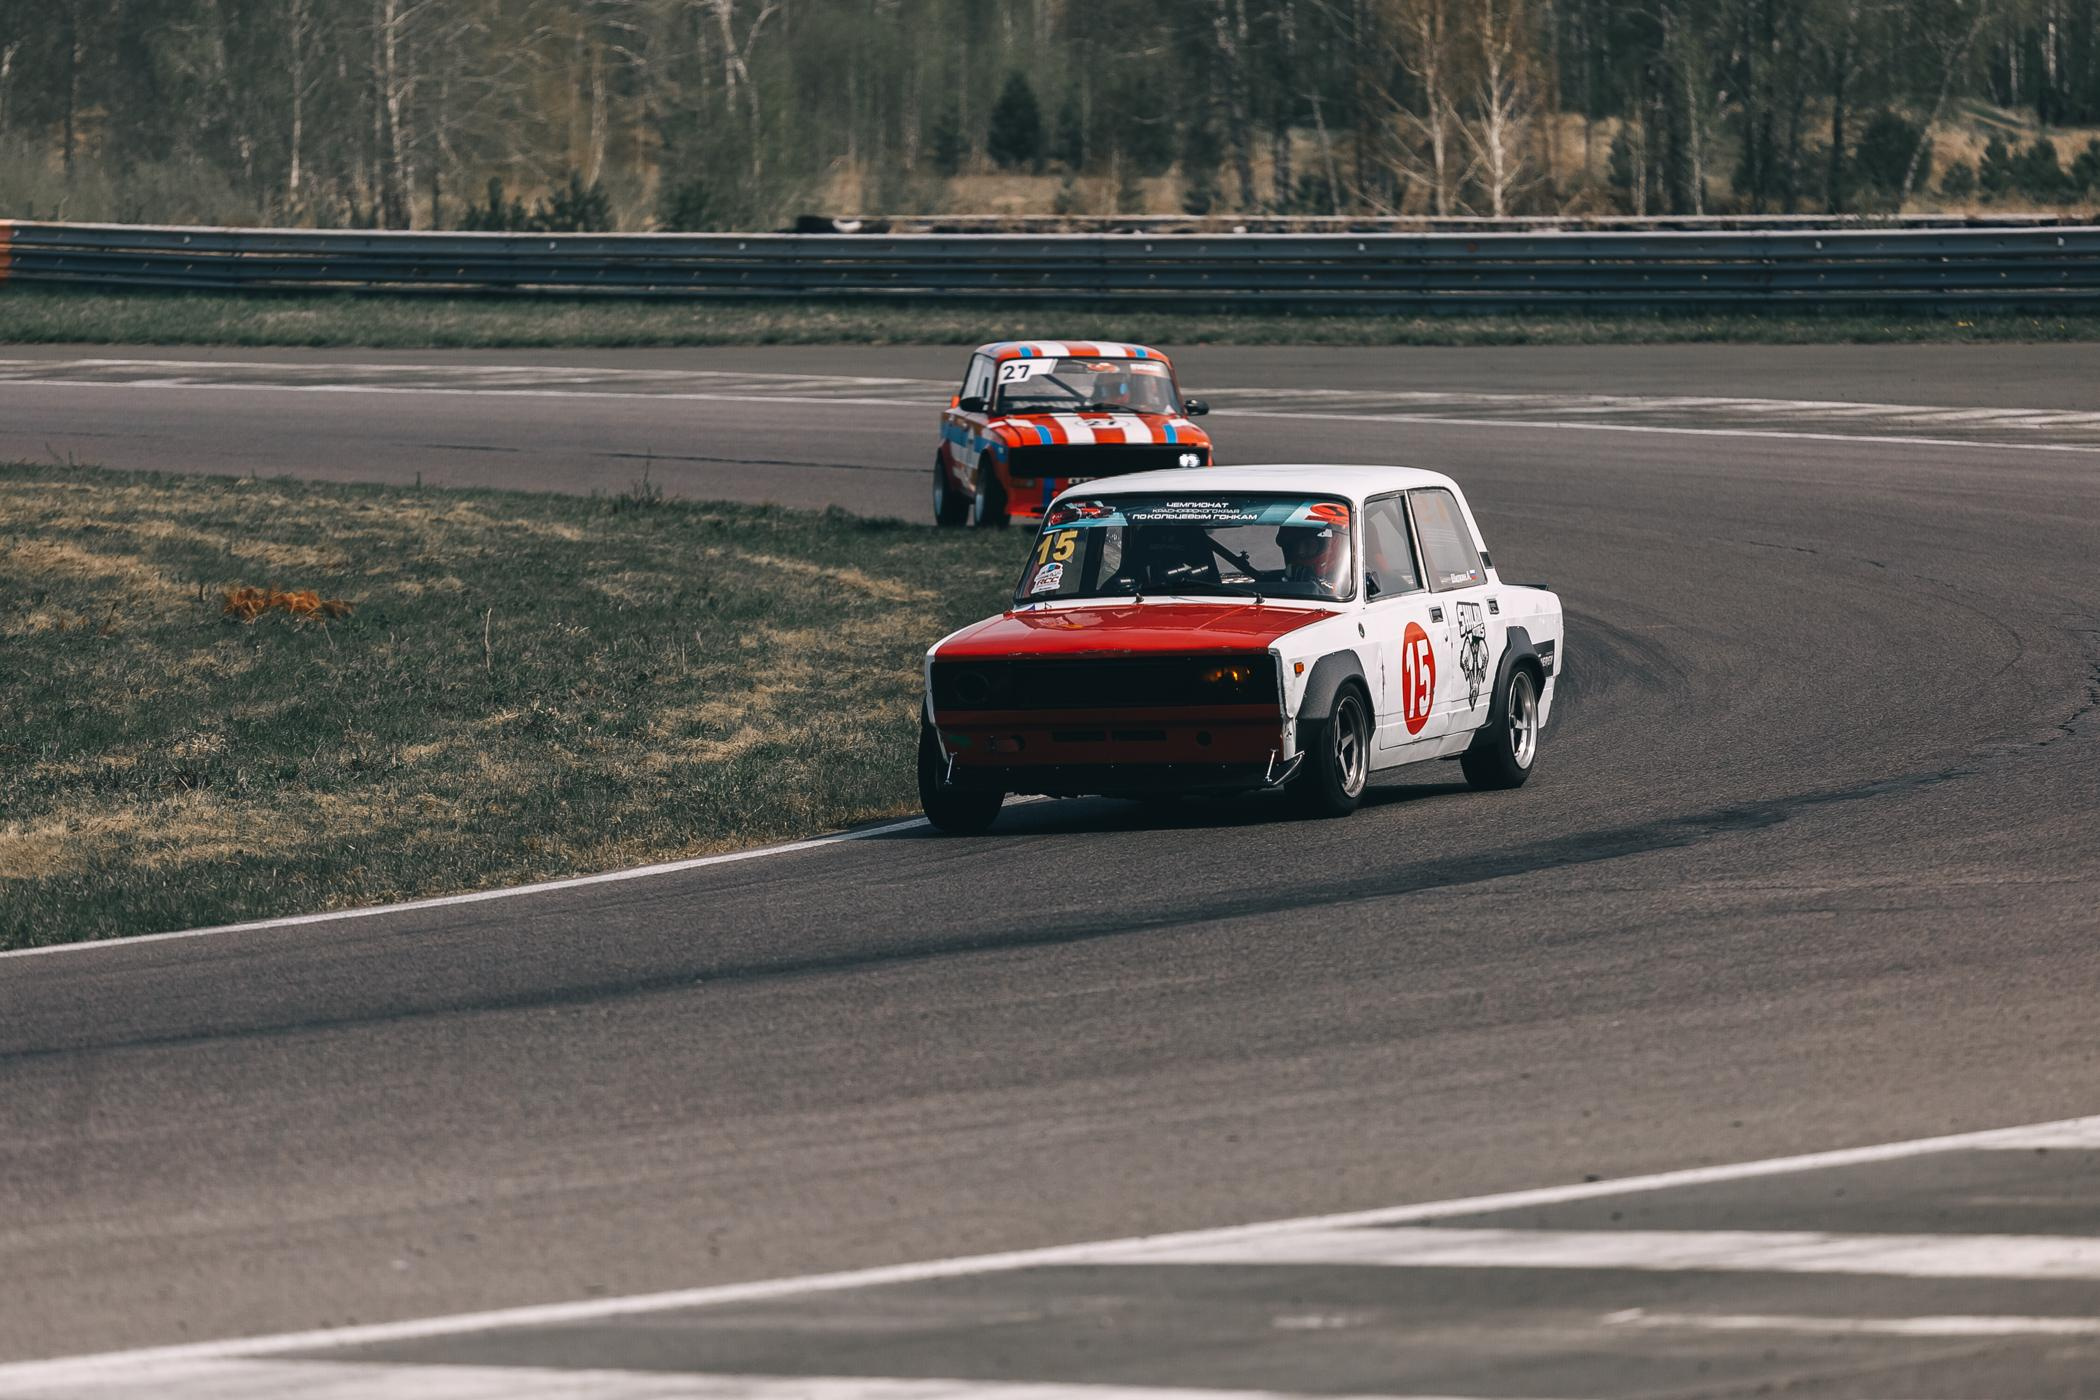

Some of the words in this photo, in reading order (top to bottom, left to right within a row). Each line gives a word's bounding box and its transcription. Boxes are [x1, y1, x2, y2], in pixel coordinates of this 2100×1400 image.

[1003, 364, 1030, 380] 27
[1037, 530, 1078, 564] 15
[1406, 640, 1430, 717] 15
